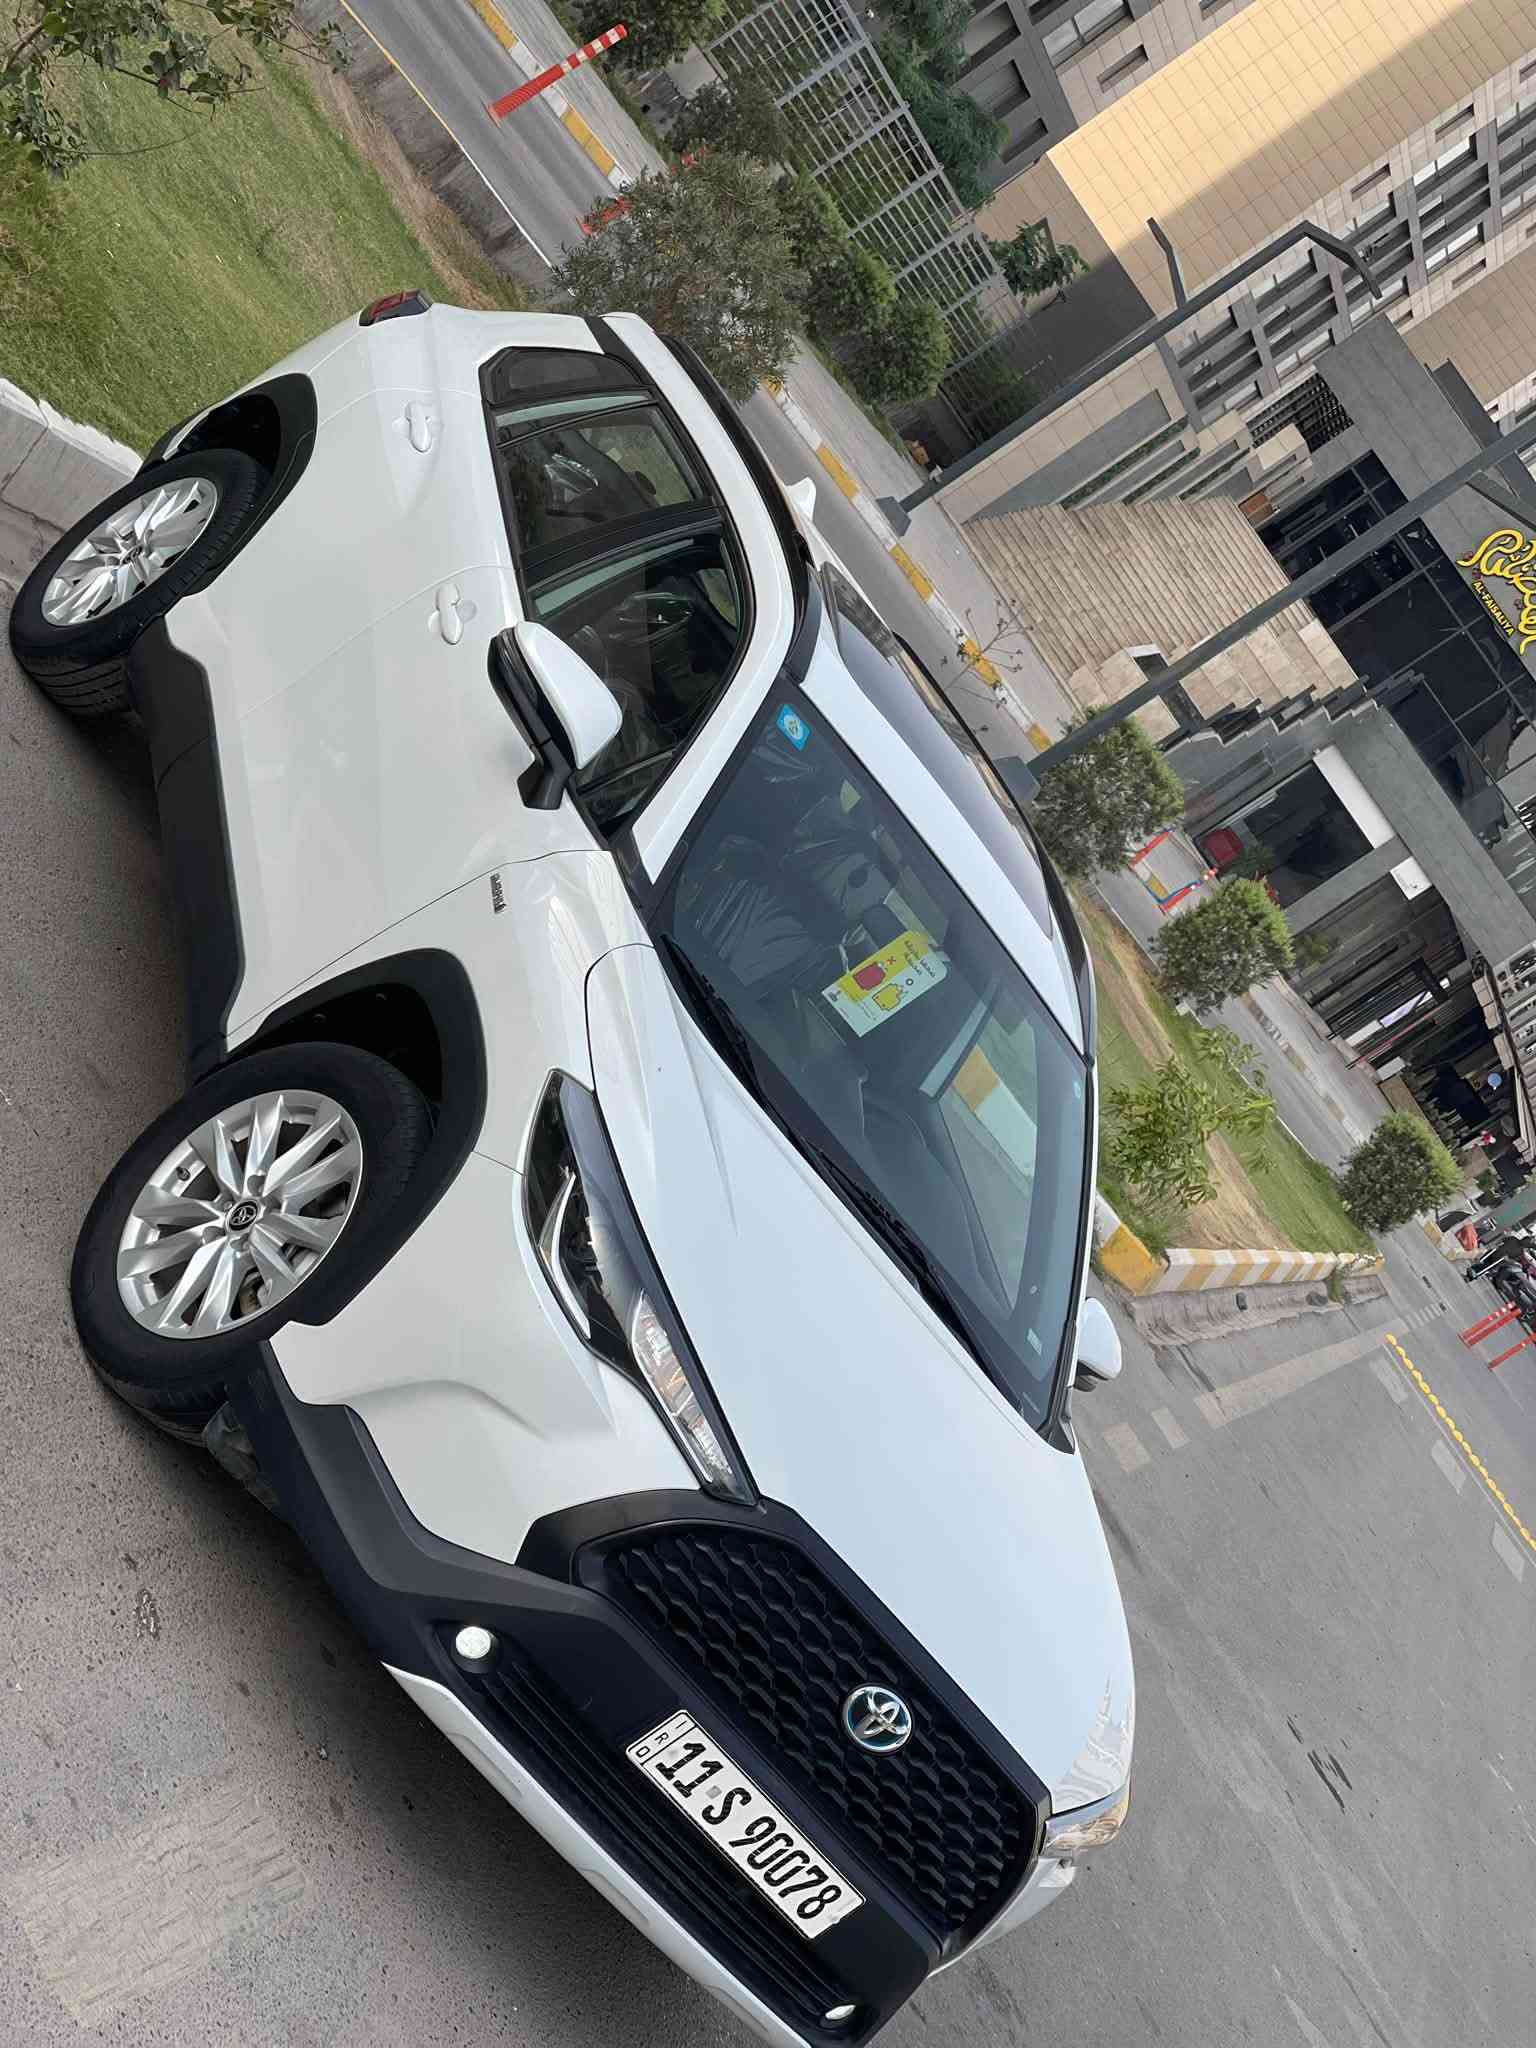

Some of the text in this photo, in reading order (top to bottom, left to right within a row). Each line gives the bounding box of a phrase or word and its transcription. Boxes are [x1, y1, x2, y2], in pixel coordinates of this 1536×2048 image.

[1473, 580, 1516, 638] AL-FAISALIYA
[656, 1742, 842, 1920] 11 S 90078
